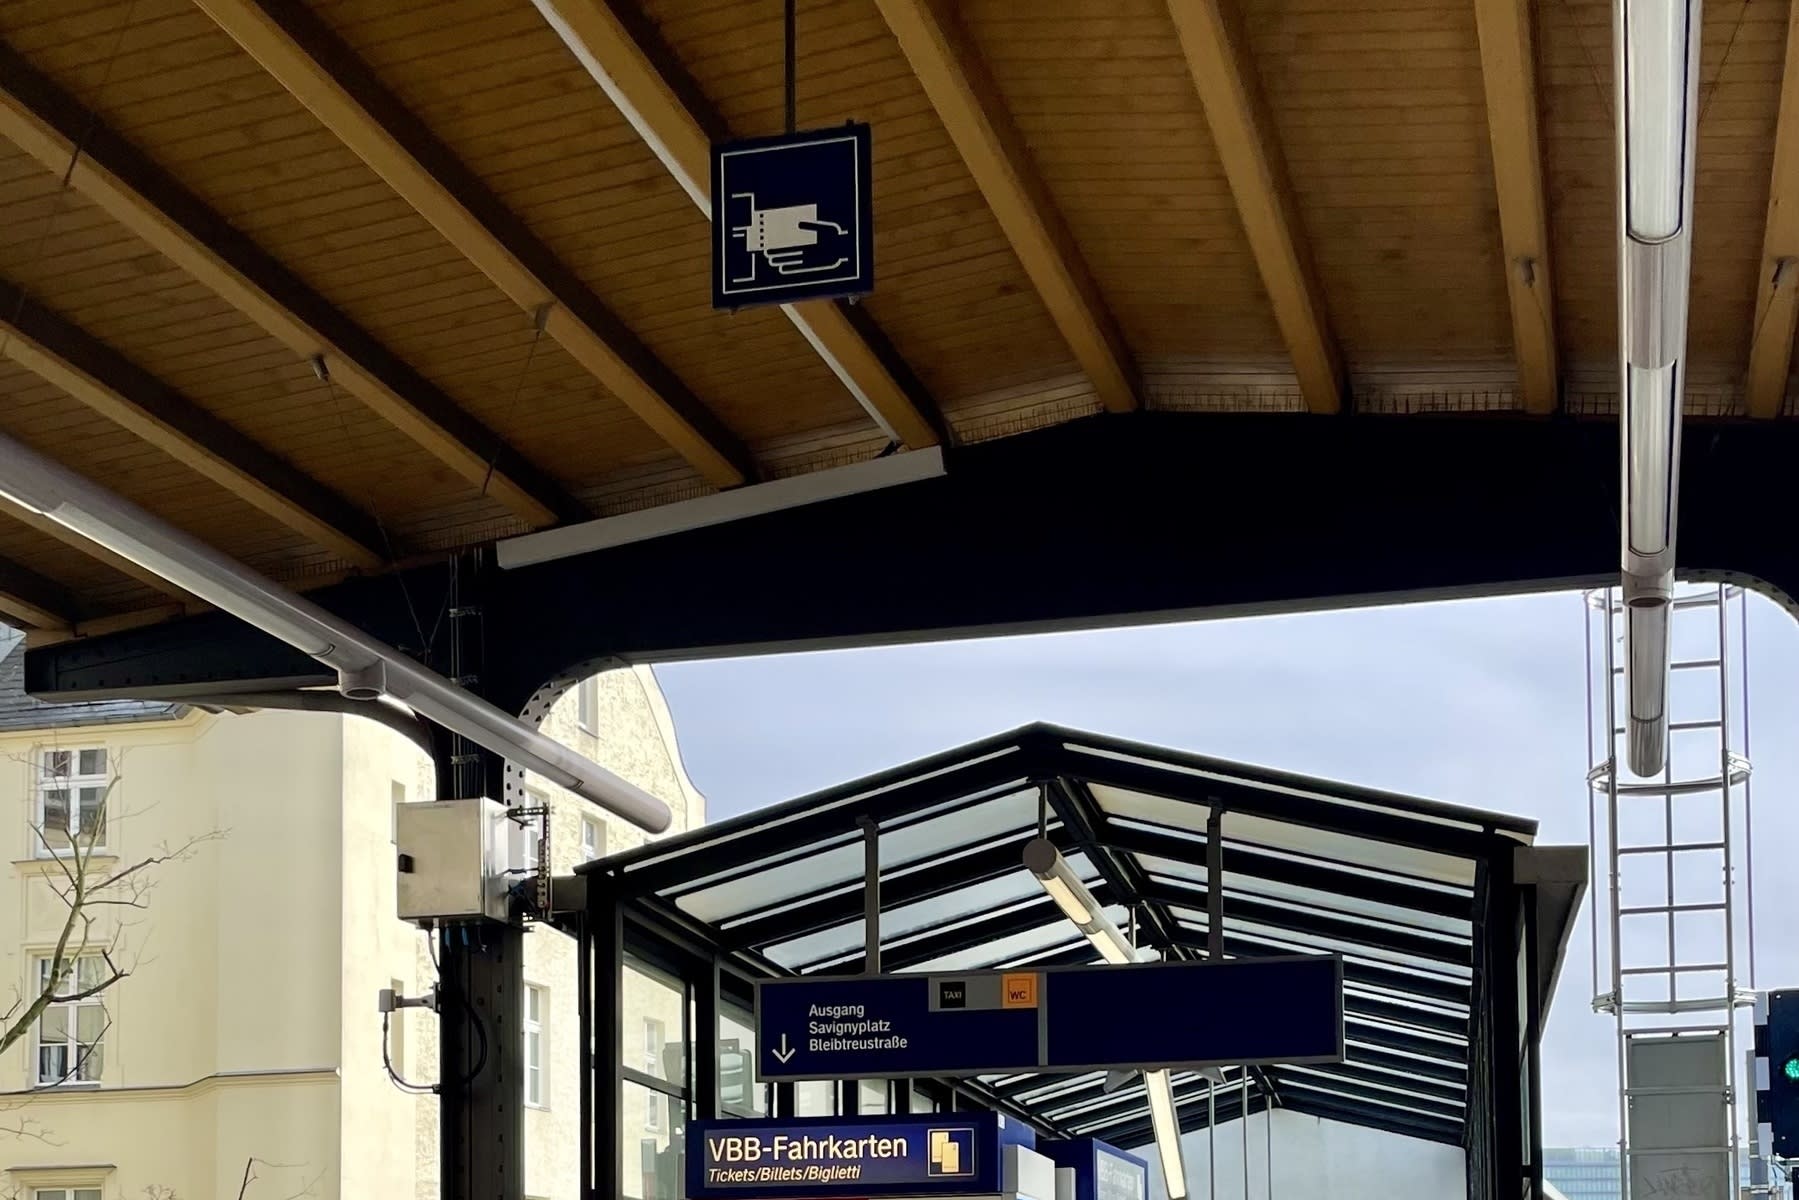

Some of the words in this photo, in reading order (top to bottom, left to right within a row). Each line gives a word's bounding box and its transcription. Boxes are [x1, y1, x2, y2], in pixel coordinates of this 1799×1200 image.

[943, 990, 962, 999] TAXI
[1010, 990, 1026, 1000] WC
[809, 1004, 865, 1018] Ausgang
[809, 1019, 891, 1036] Savignyplatz
[809, 1035, 908, 1052] Bleibtreustraße
[709, 1135, 908, 1162] VBB-Fahrkarten
[708, 1164, 861, 1183] Tickets/Billets/Biglietti
